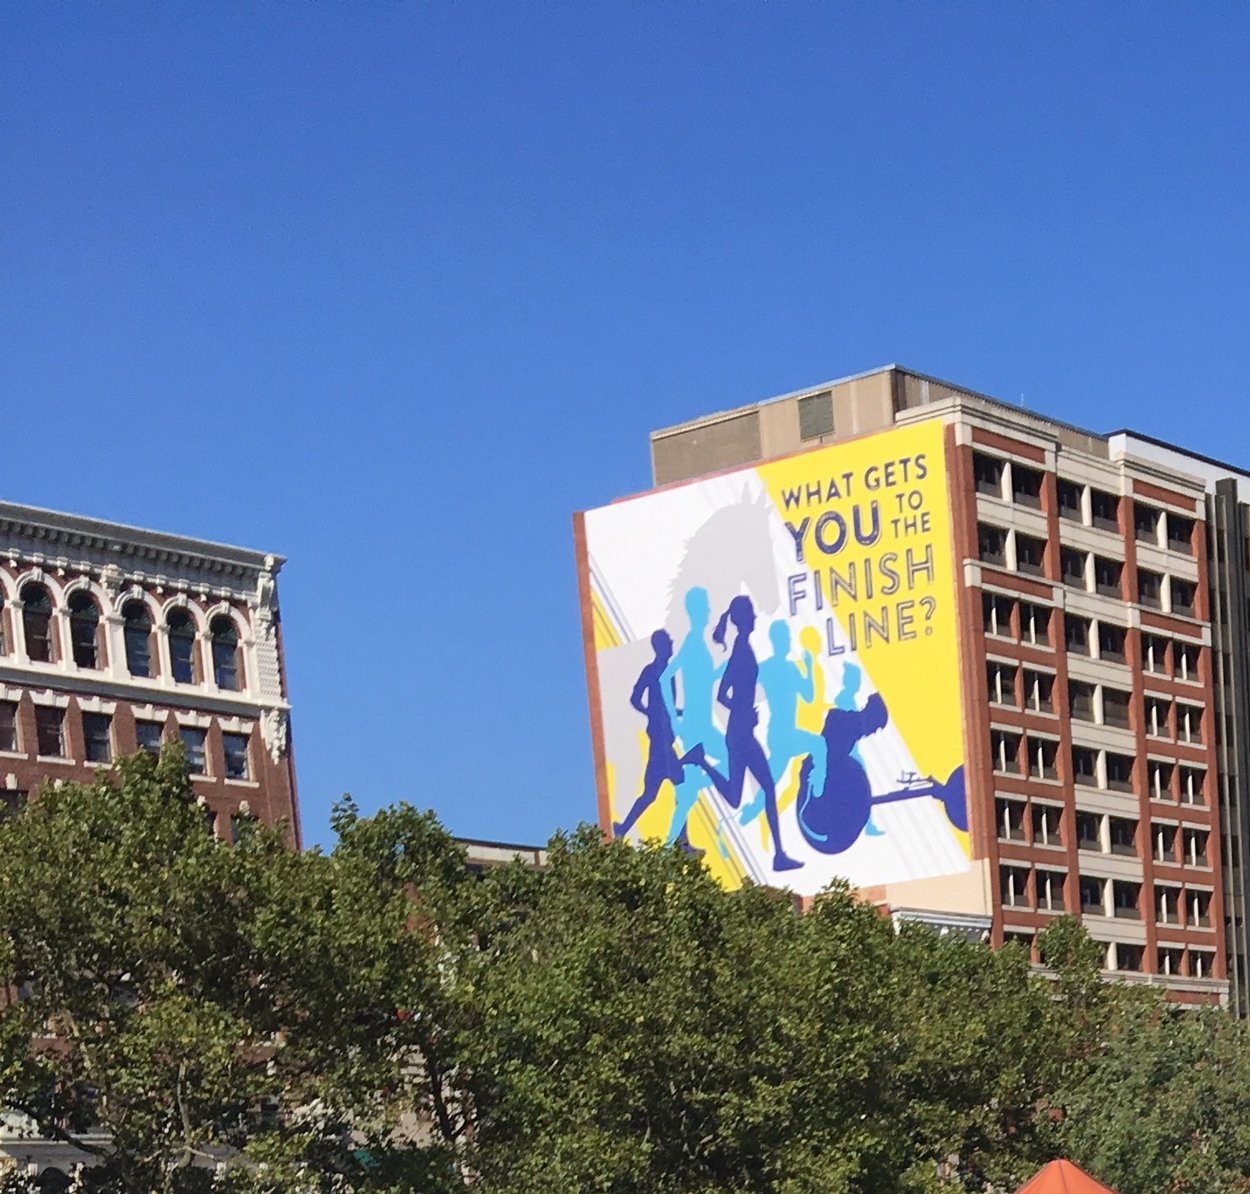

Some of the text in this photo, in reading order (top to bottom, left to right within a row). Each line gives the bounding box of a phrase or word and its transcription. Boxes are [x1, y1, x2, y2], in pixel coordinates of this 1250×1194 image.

[782, 454, 927, 511] WHAT GETS
[895, 490, 923, 513] TO
[785, 500, 882, 563] YOU
[891, 511, 931, 538] THE
[788, 544, 934, 617] FINISH
[826, 596, 936, 656] LINE?
